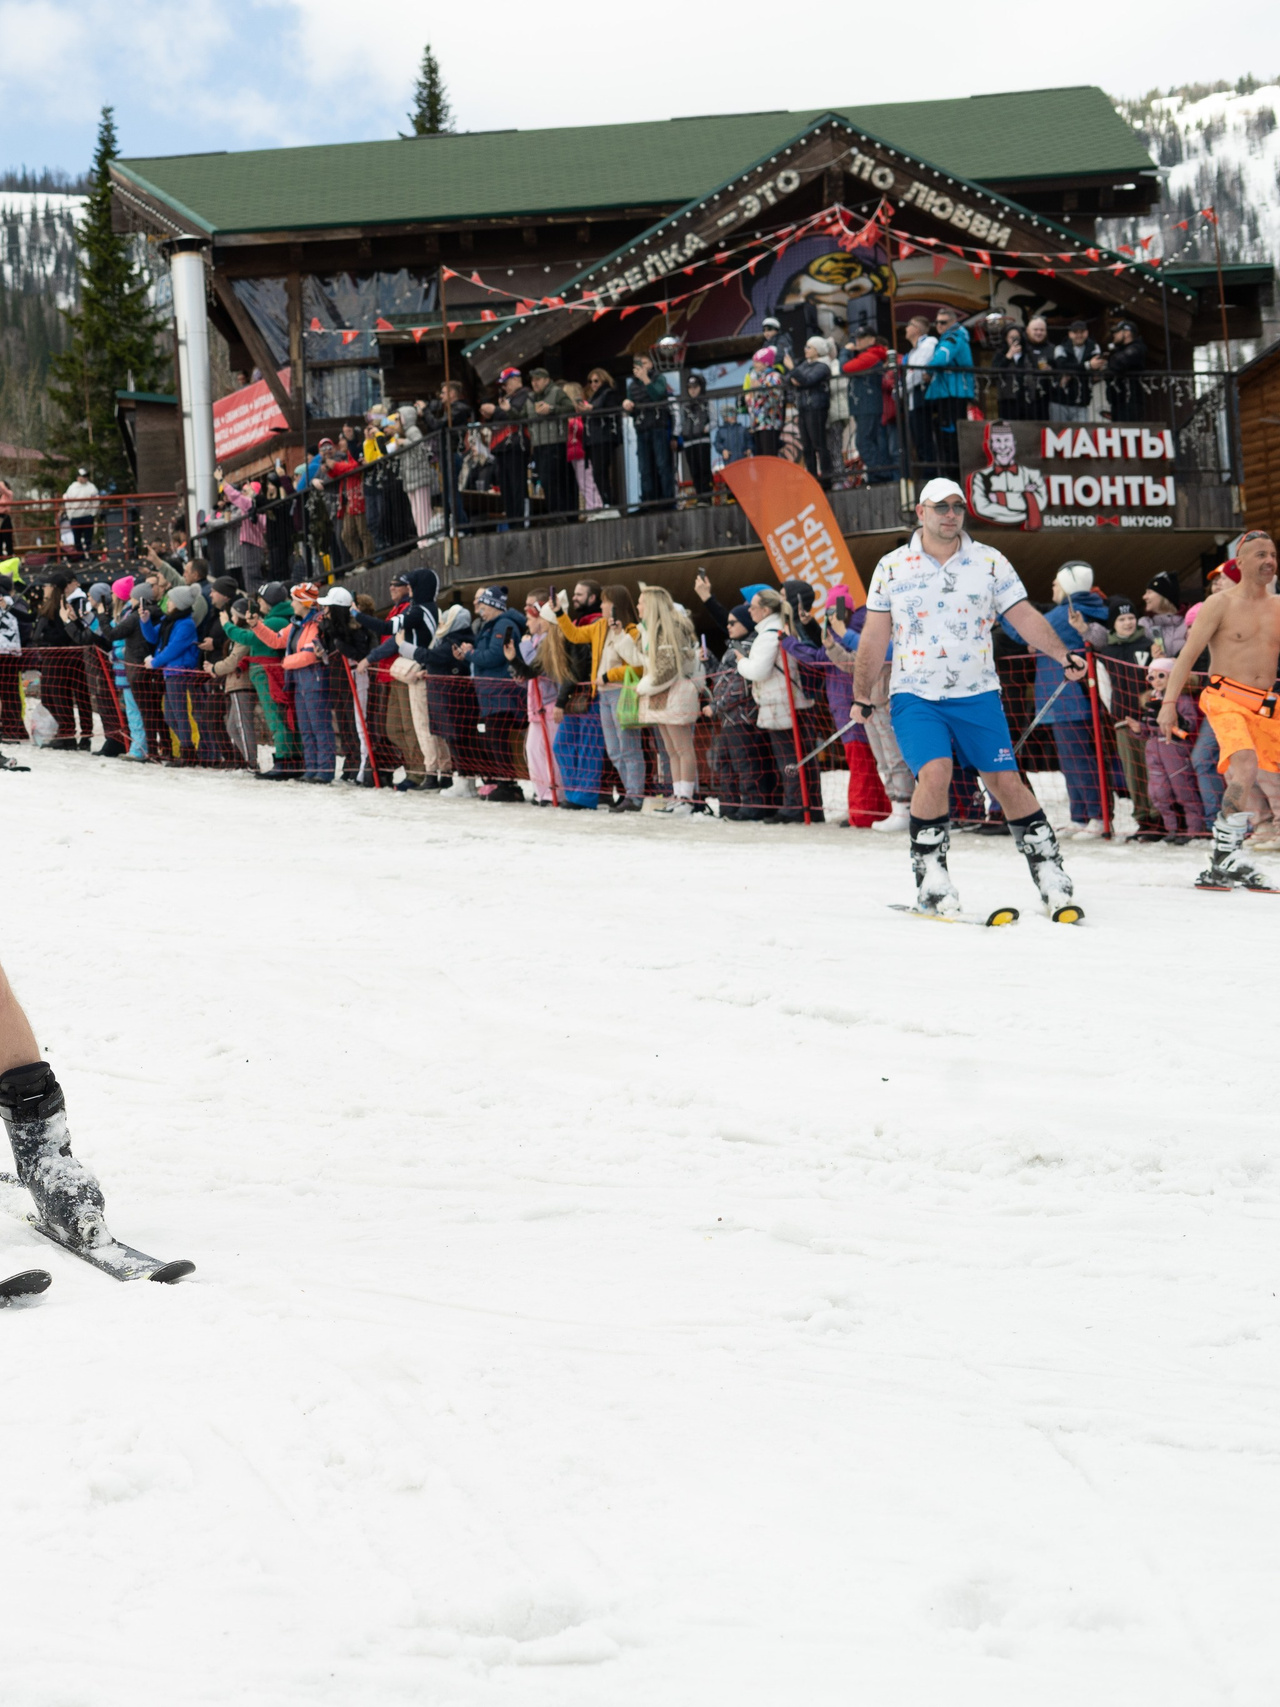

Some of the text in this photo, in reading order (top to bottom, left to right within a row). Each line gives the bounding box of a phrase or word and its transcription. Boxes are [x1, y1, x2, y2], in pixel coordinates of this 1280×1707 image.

[850, 153, 1011, 249] ПО ЛЮБВИ
[592, 233, 708, 315] ГРЕЛКА
[738, 169, 801, 218] ЭТО
[1042, 427, 1175, 459] МАНТЫ
[1047, 474, 1176, 508] ПОНТЫ
[1043, 515, 1173, 527] БЫСТРО ВКУСНО
